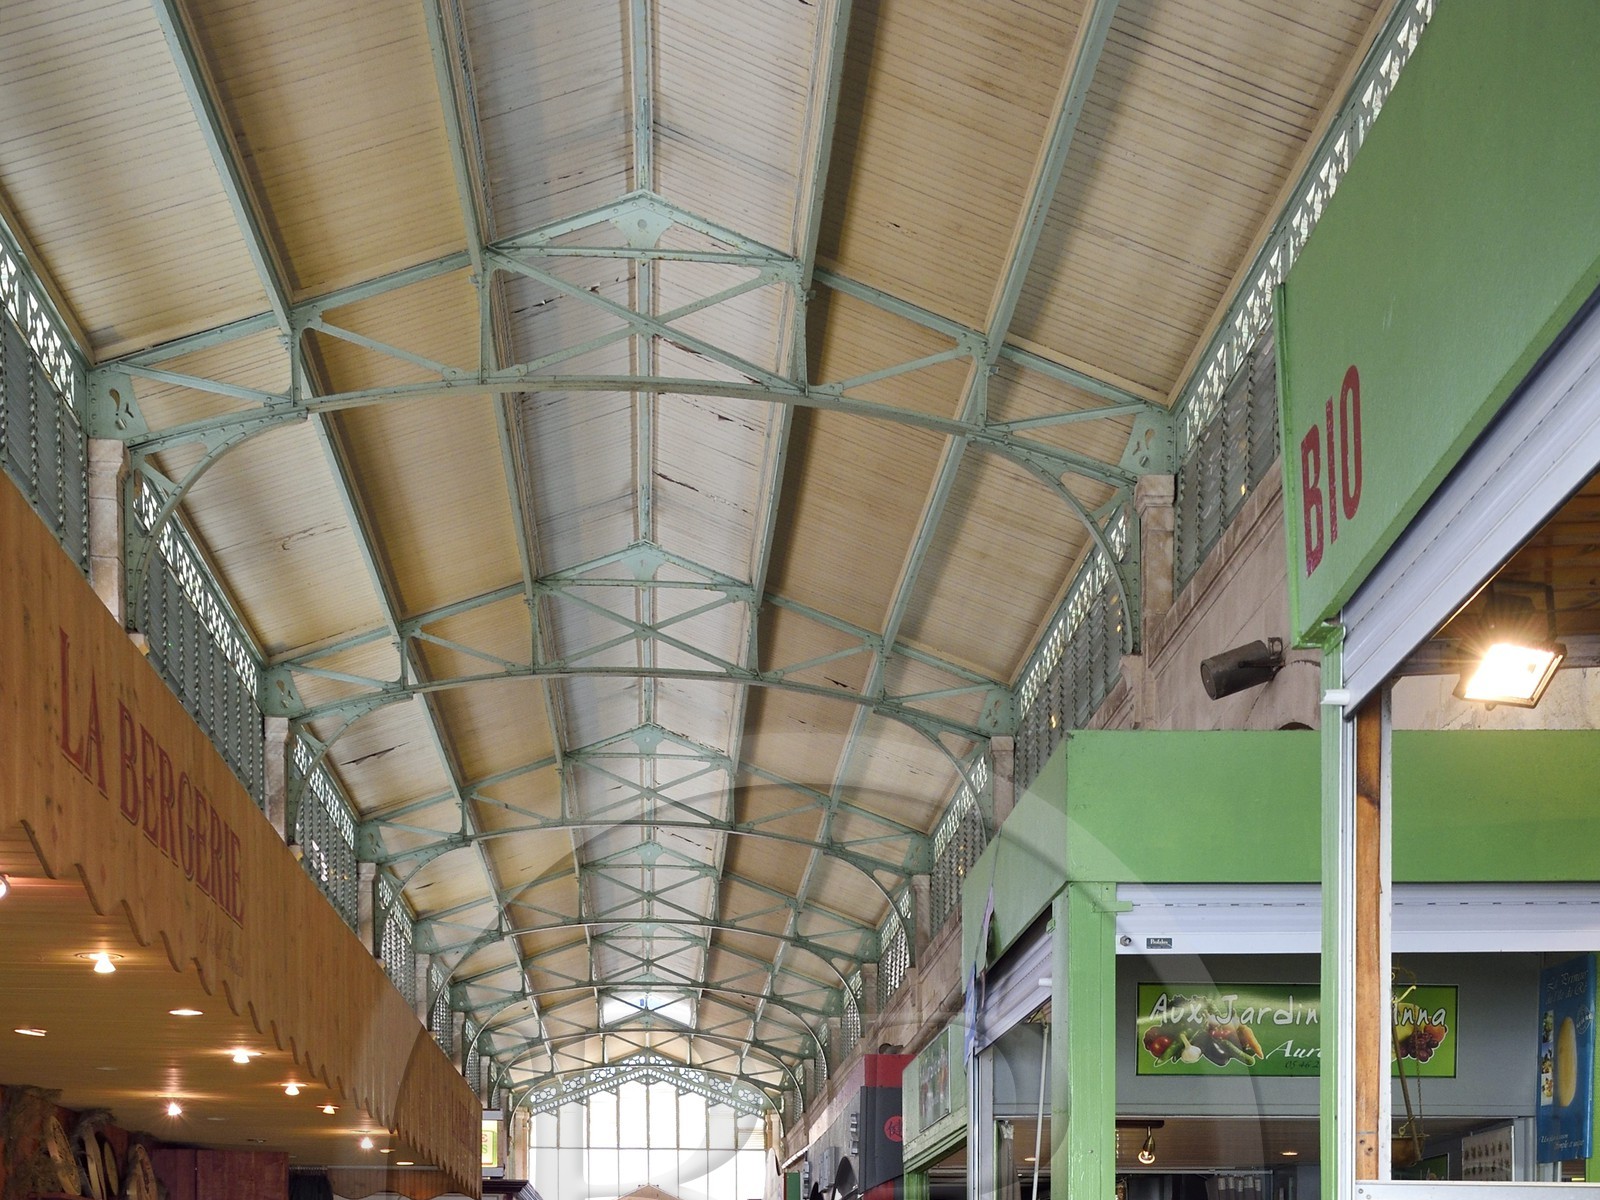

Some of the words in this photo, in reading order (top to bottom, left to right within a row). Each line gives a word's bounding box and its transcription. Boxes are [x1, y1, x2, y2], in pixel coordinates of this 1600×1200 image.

[1300, 364, 1363, 579] BIO
[58, 626, 109, 801] LA
[117, 699, 245, 930] BERGERIE
[1149, 993, 1203, 1025] Aux
